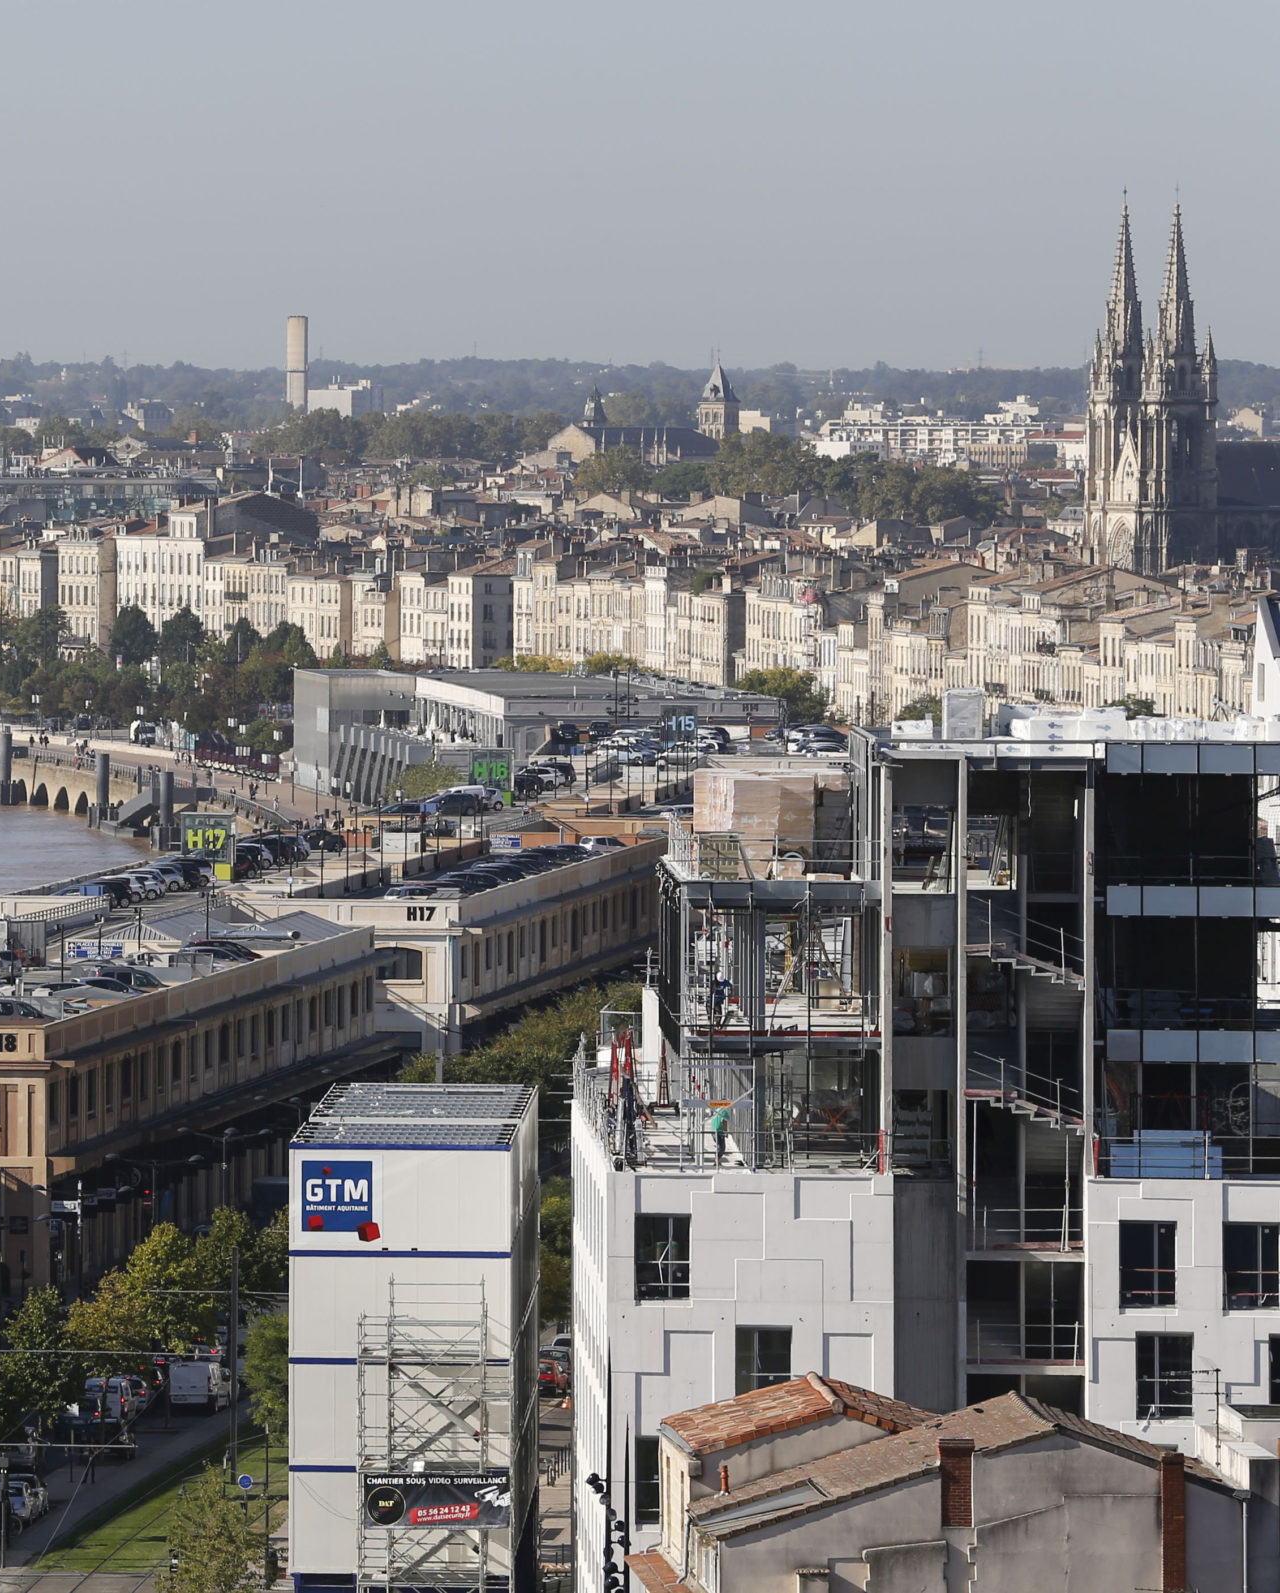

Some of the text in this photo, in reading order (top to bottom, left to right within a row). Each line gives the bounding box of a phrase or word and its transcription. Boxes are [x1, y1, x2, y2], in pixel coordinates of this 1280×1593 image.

[473, 761, 508, 780] H16
[187, 828, 226, 850] H17
[406, 906, 437, 922] H17
[306, 1178, 369, 1203] GTM
[366, 1477, 404, 1485] CHANTIER
[406, 1477, 426, 1486] SOUS
[453, 1476, 507, 1485] SURVEILLANCE
[417, 1509, 427, 1517] 05
[428, 1508, 438, 1516] 56
[417, 1511, 471, 1522] www.datsecurity.fr
